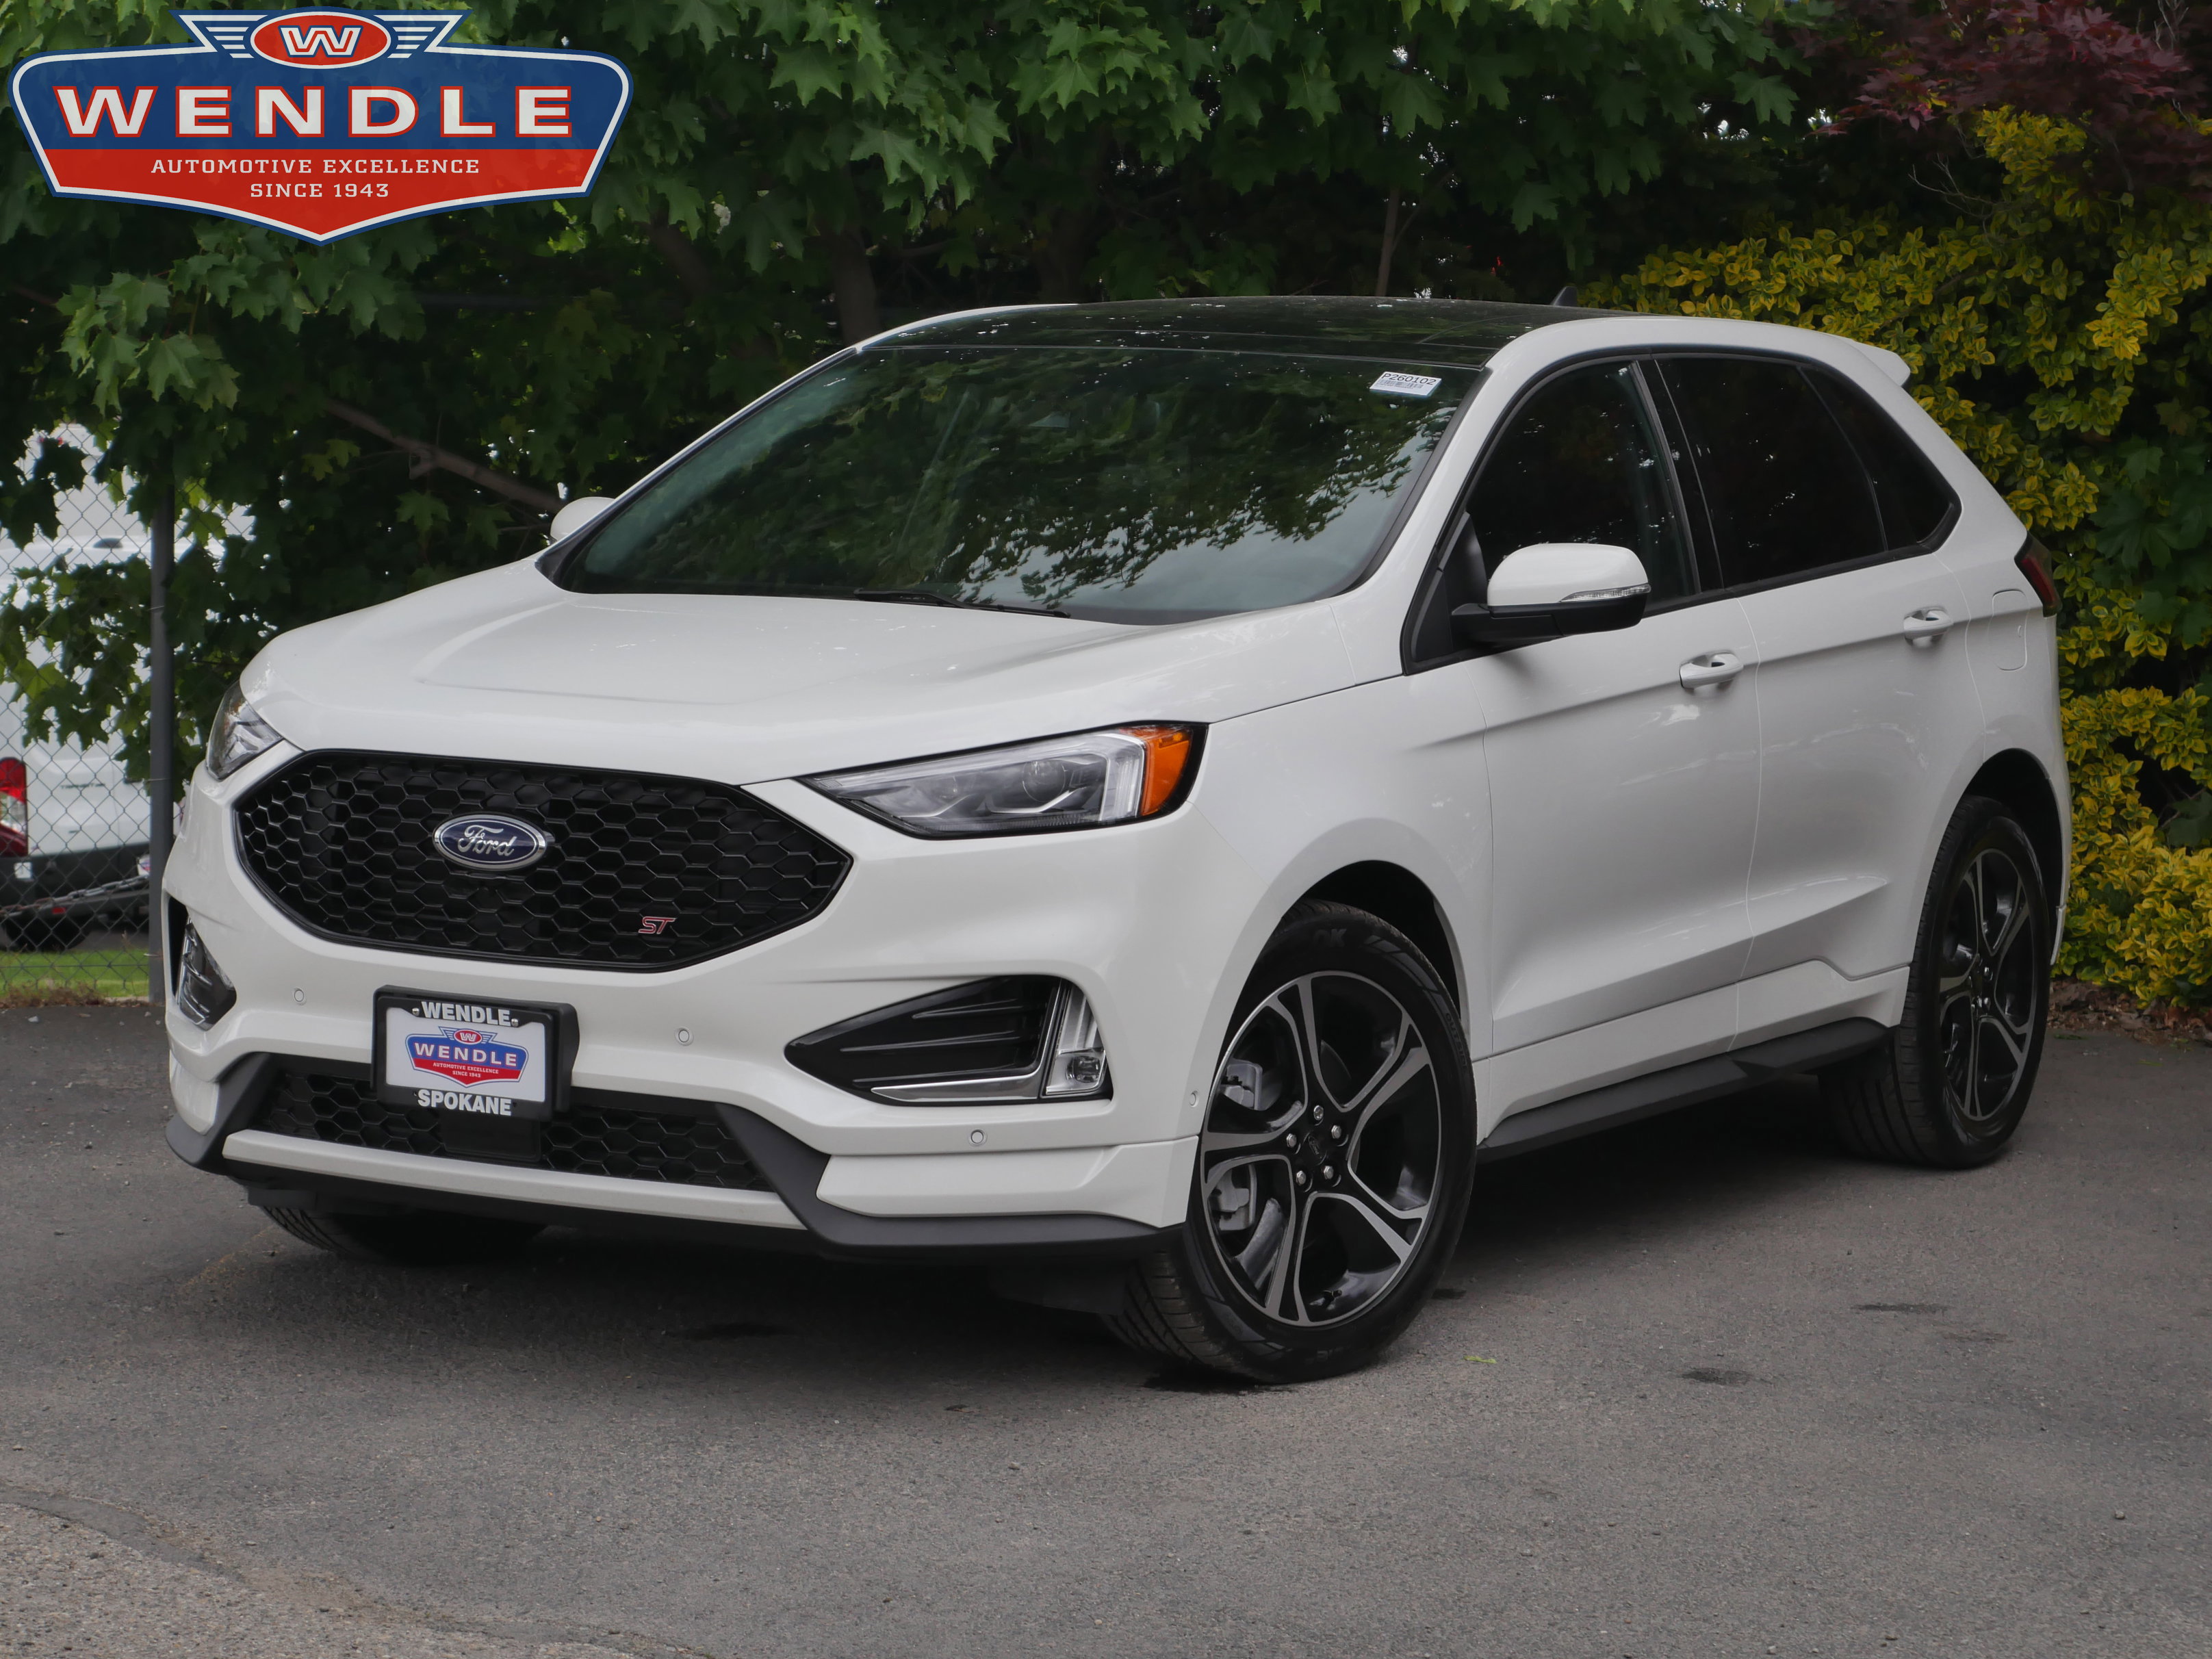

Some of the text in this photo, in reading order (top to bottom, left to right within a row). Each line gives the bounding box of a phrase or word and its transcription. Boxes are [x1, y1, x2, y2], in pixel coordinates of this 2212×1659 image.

[1381, 373, 1437, 385] P260102
[457, 825, 517, 856] Ford
[638, 916, 676, 934] ST
[422, 1001, 511, 1027] WENDLE
[414, 1042, 517, 1067] WENDLE
[433, 1062, 499, 1075] AUTOMOTIVE EXCELLENCE
[417, 1089, 512, 1116] SPOKANE
